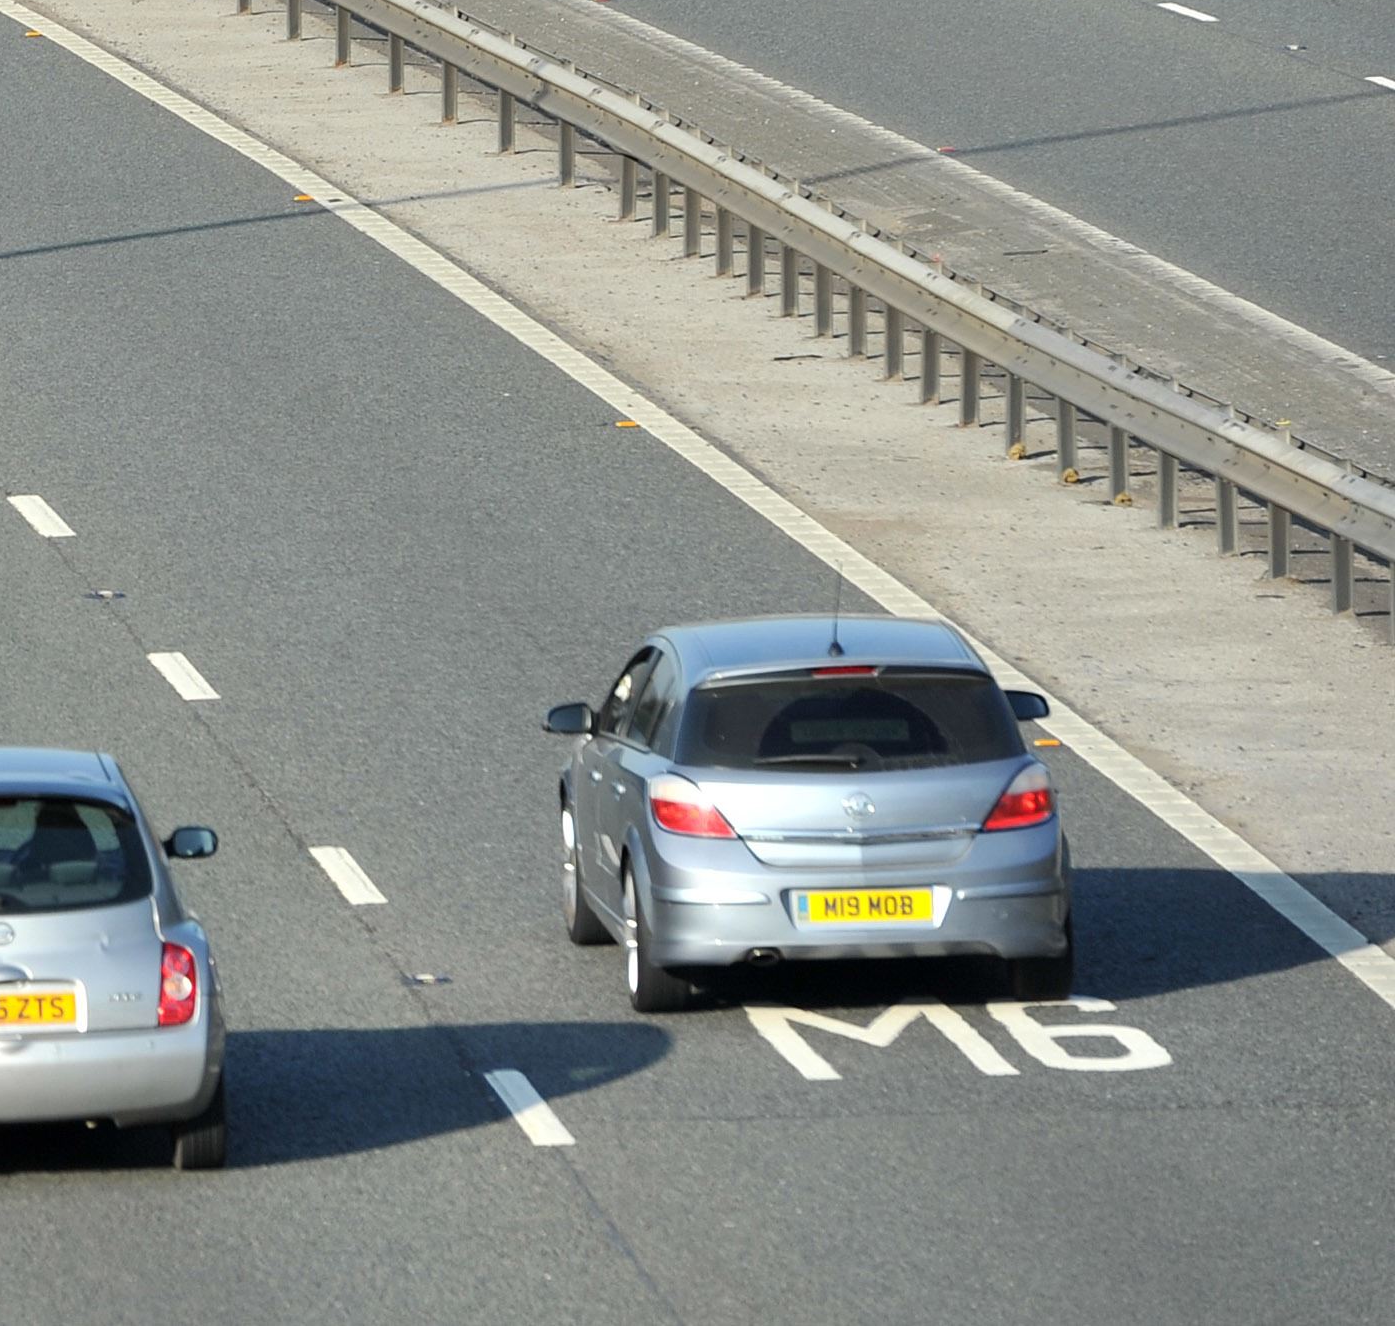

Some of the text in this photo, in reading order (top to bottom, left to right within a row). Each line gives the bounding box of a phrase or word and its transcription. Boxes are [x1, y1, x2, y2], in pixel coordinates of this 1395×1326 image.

[824, 894, 915, 917] M19 MOB
[17, 996, 65, 1021] ZTS
[744, 999, 1174, 1081] M6
